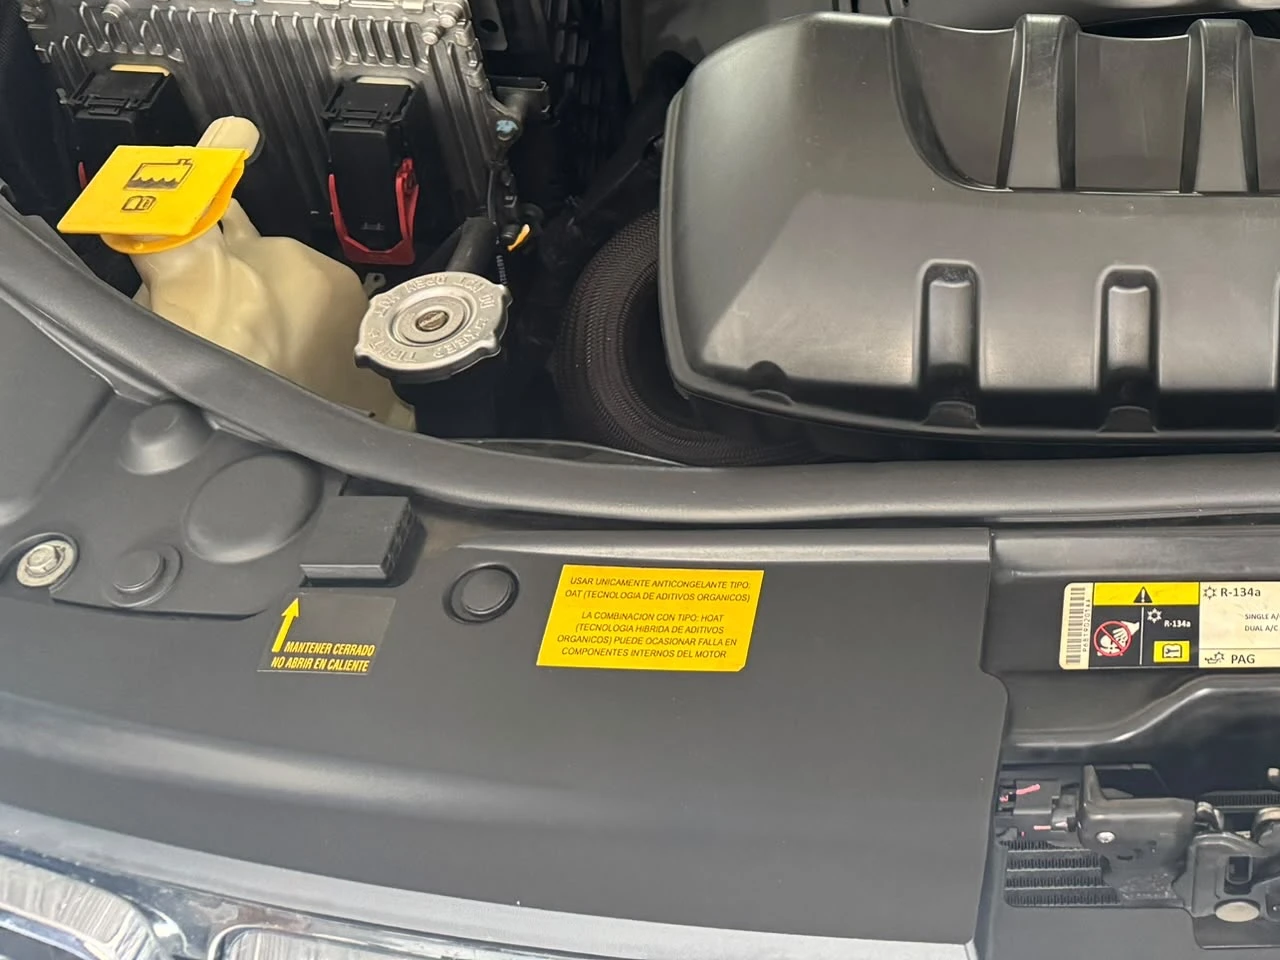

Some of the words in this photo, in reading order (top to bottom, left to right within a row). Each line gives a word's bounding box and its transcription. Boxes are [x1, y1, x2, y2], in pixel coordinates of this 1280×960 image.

[404, 274, 448, 293] OPEN
[570, 577, 593, 585] USAR
[596, 578, 650, 587] UNICAMENTE
[652, 580, 727, 588] ANTICONGELANTE
[730, 581, 750, 589] TIPO:
[565, 590, 582, 598] OAT
[584, 590, 641, 600] (TECNOLOGIA
[643, 592, 654, 600] DE
[697, 594, 750, 602] ORGANICOS)
[1220, 587, 1261, 597] R-134a
[594, 612, 655, 620] COMBINACION
[576, 623, 633, 632] (TECNOLOGIA
[685, 626, 724, 634] ADITIVOS
[1164, 620, 1191, 628] R-134a
[557, 635, 612, 645] ORGANICOS)
[614, 636, 644, 644] PUEDE
[646, 637, 696, 646] OCASIONAR
[698, 638, 722, 646] FALLA
[725, 638, 737, 646] EN
[284, 641, 332, 654] MANTENER
[332, 643, 376, 656] CERRADO
[562, 647, 628, 656] COMPONENTES
[695, 650, 726, 658] MOTOR
[270, 656, 285, 669] NO
[285, 657, 313, 670] ABRIR
[313, 658, 327, 670] EN
[327, 659, 370, 672] CALIENTE
[1231, 654, 1255, 664] PAG
